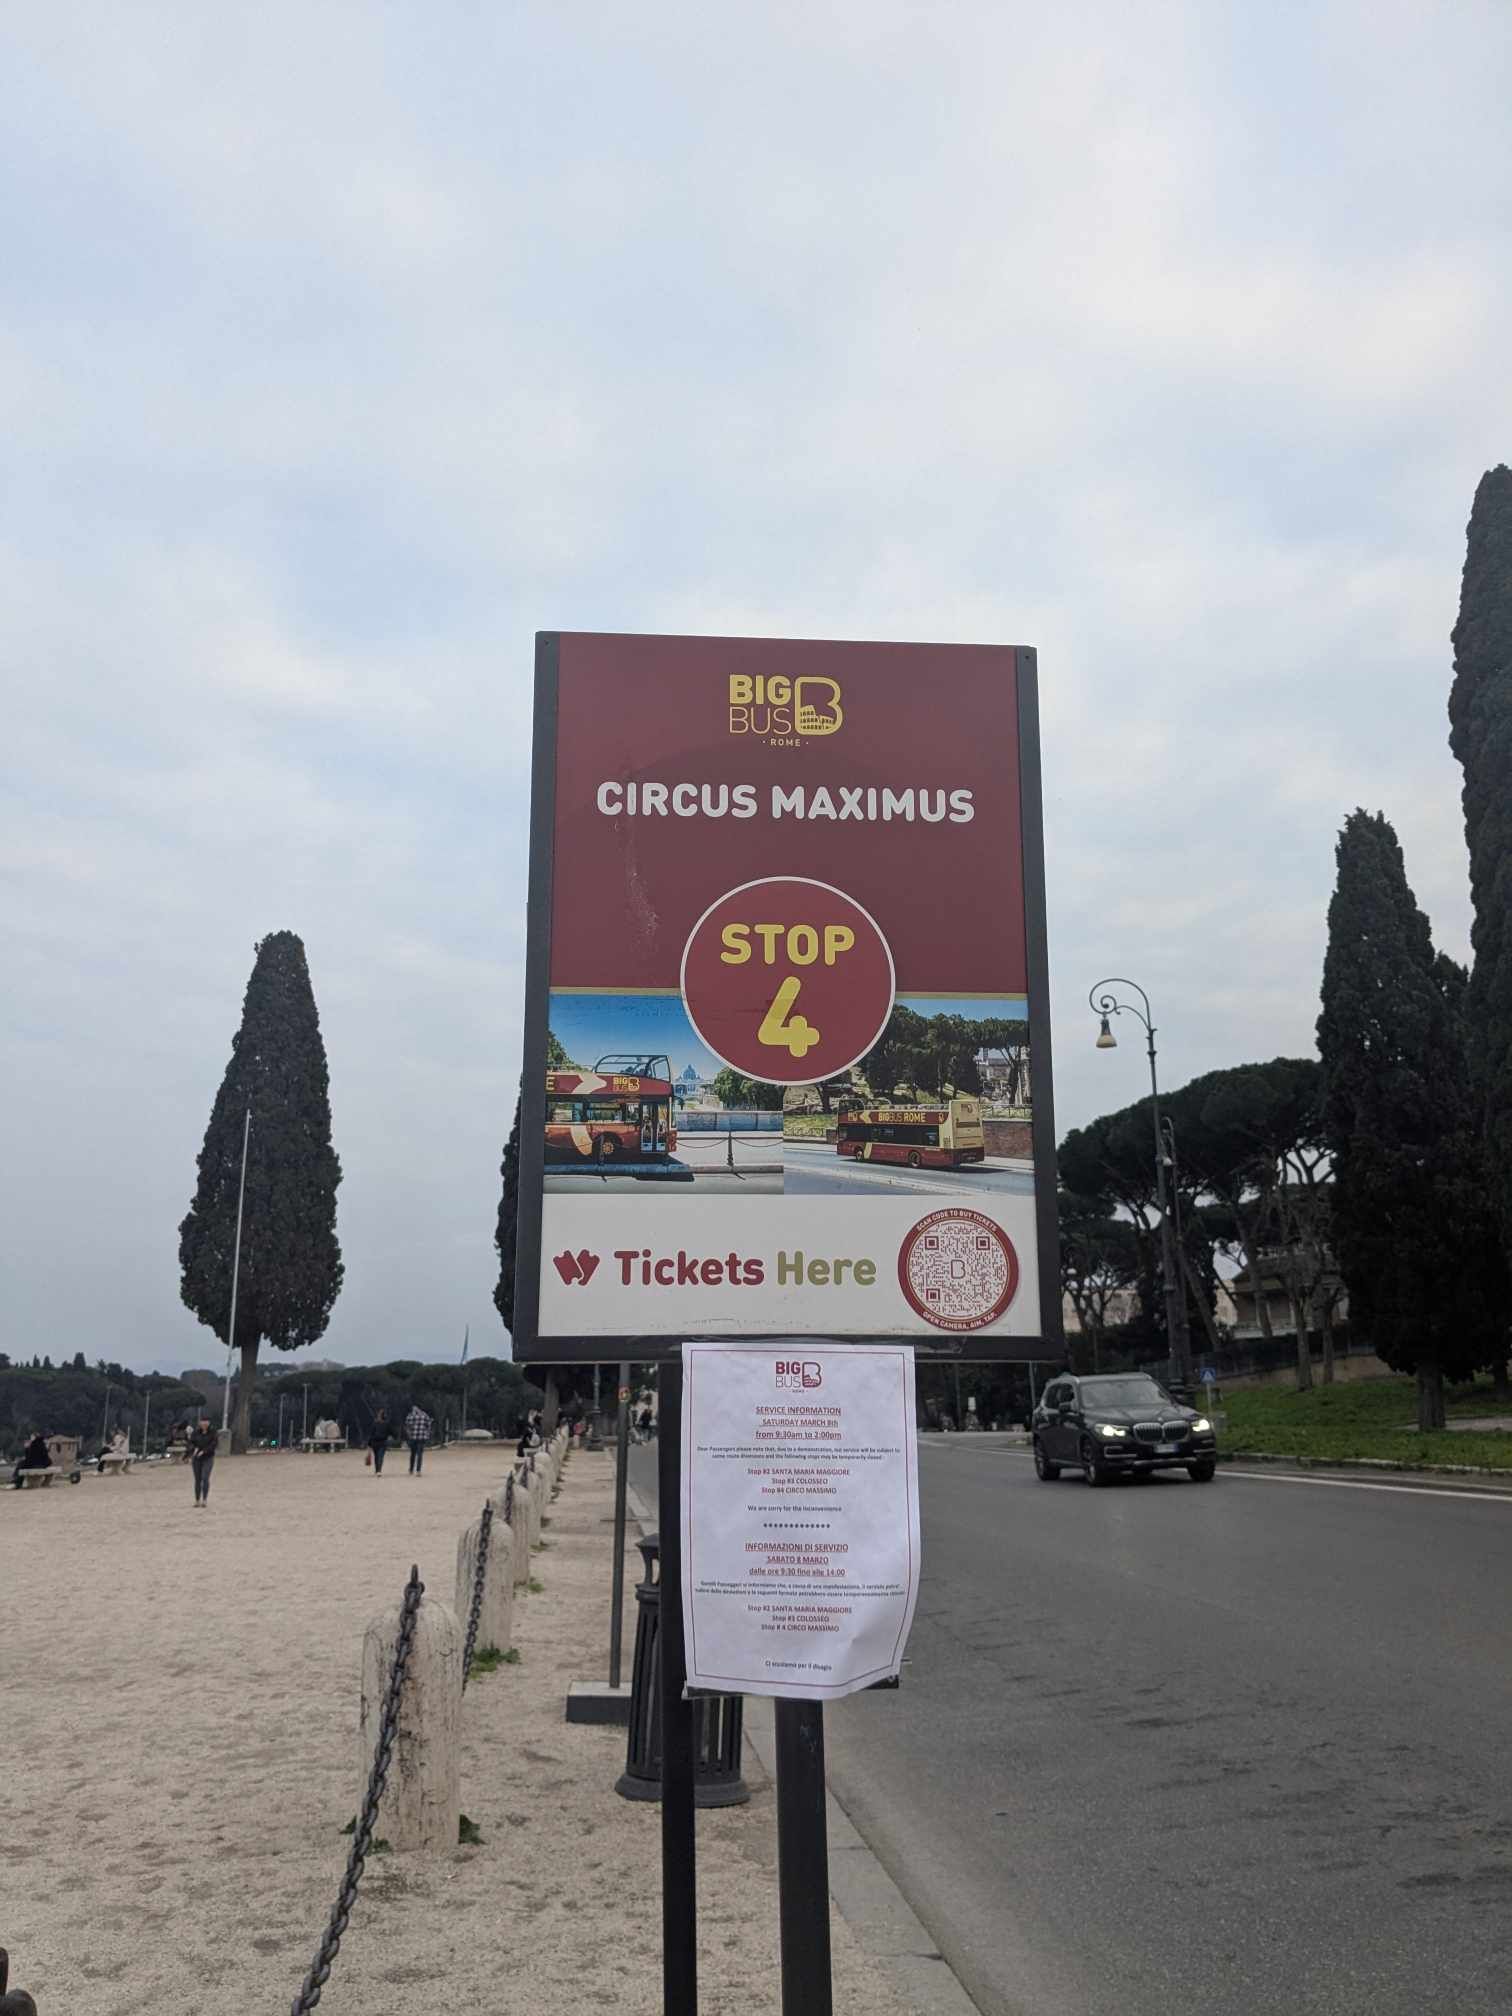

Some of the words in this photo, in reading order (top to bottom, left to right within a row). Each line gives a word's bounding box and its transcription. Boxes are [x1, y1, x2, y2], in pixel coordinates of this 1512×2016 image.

[729, 674, 791, 705] BIG
[729, 707, 791, 734] BUS
[770, 738, 801, 747] ROME
[597, 781, 758, 818] CIRCUS
[771, 785, 975, 822] MAXIMUS
[720, 923, 855, 966] STOP
[758, 976, 820, 1058] 4
[933, 1211, 948, 1221] CODE
[960, 1210, 972, 1218] BUY
[973, 1213, 997, 1231] TICKETS
[614, 1249, 765, 1286] Tickets
[777, 1250, 877, 1286] Here
[922, 1311, 939, 1325] OPEN
[776, 1361, 801, 1375] BIG
[776, 1376, 801, 1388] BUS
[756, 1407, 785, 1415] SERVICE
[788, 1407, 841, 1416] INFORMATION
[756, 1431, 773, 1439] from
[805, 1431, 813, 1439] to
[745, 1544, 802, 1552] INFORMAZIONI
[805, 1544, 813, 1552] DI
[815, 1544, 848, 1552] SERVIZIO
[750, 1568, 765, 1576] dalle
[768, 1568, 778, 1576] ore
[797, 1568, 811, 1576] fino
